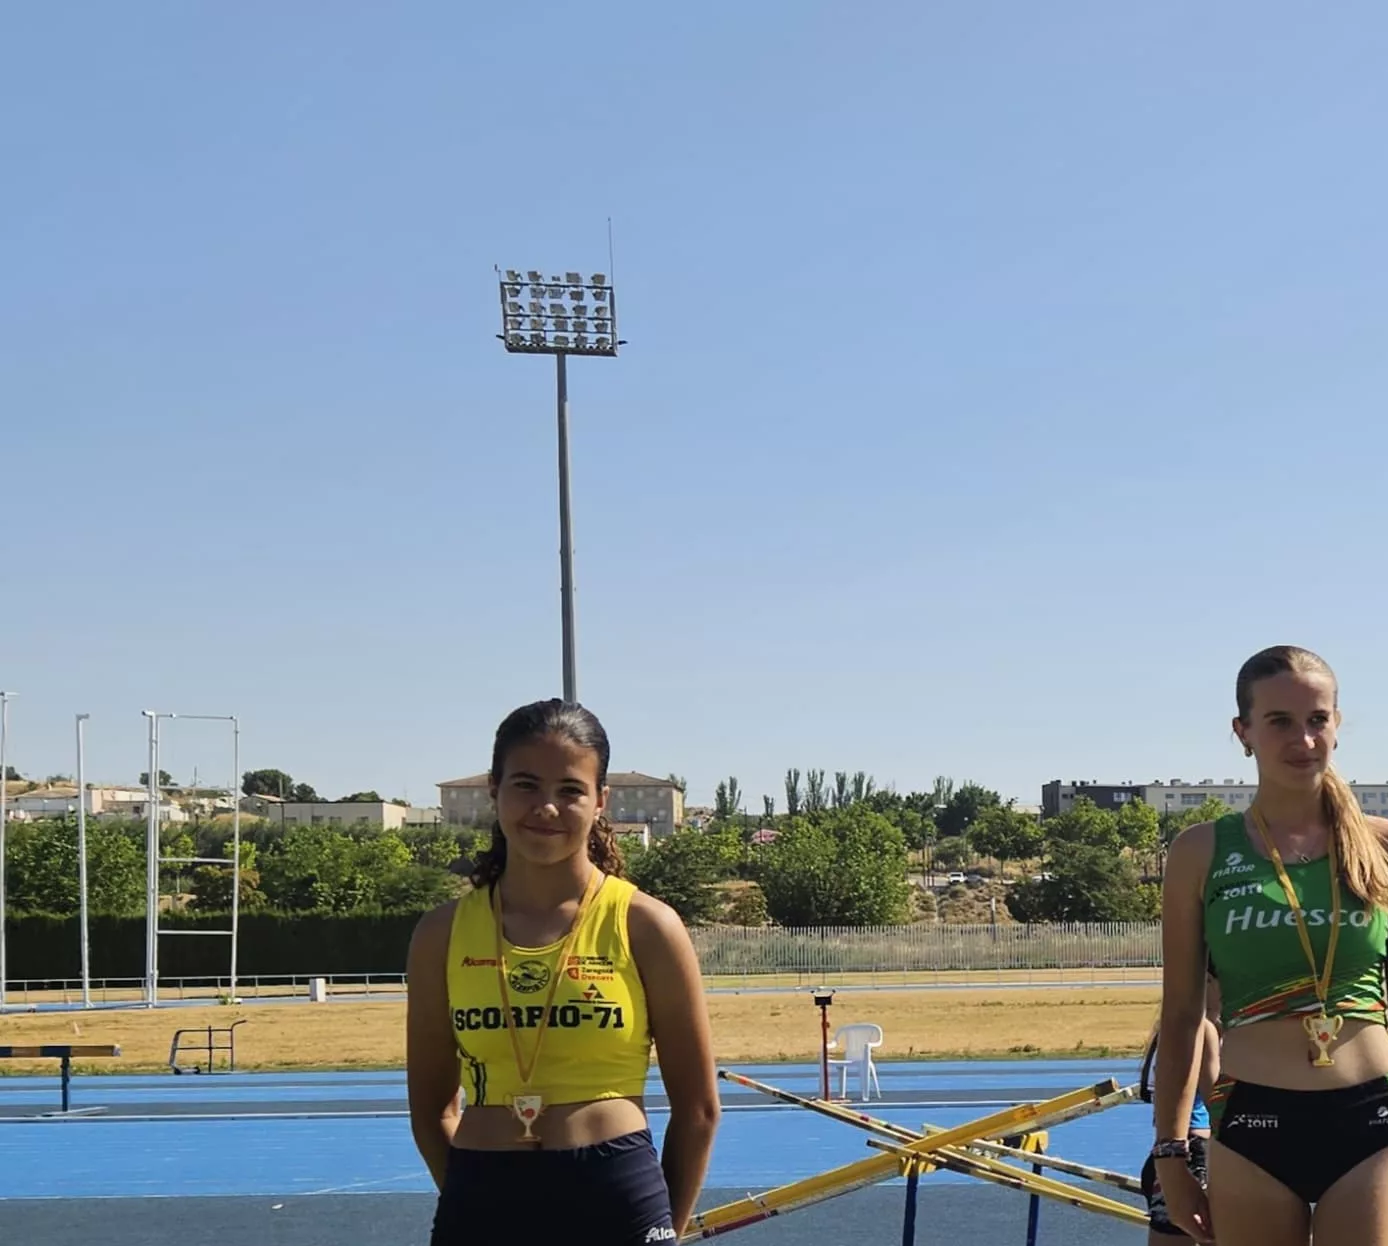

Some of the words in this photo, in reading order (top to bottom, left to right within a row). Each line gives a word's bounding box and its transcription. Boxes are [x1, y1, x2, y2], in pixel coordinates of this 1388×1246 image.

[1225, 906, 1373, 935] Huesca
[455, 1004, 625, 1032] SCORPIO-71
[1247, 1119, 1279, 1129] ZOITI
